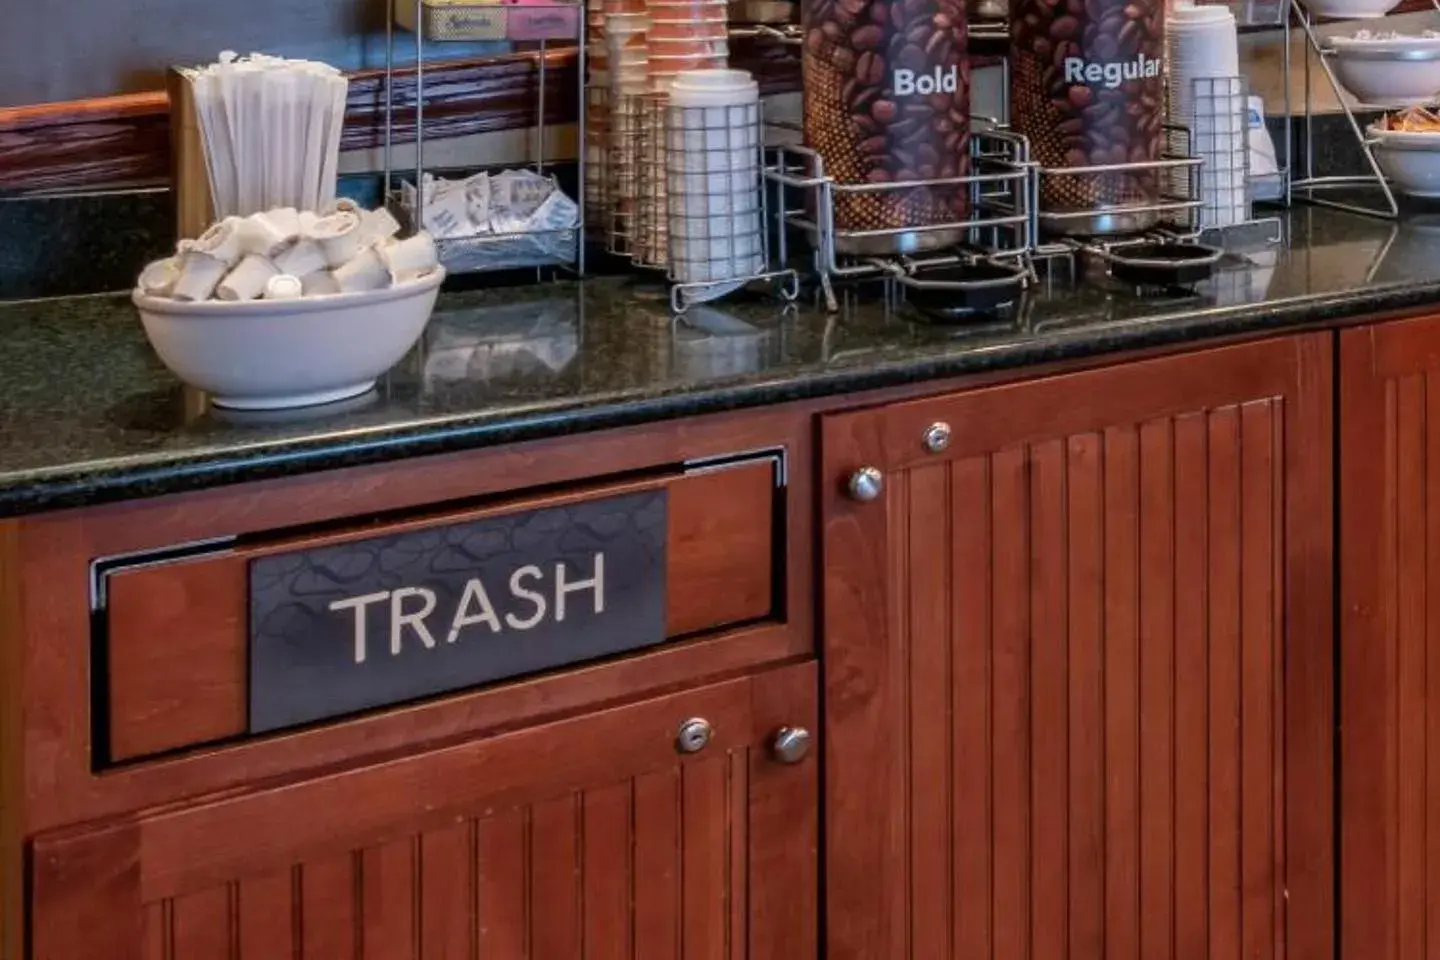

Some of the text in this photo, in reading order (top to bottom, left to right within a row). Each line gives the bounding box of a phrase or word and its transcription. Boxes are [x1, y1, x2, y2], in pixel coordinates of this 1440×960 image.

[893, 65, 958, 96] Bold
[1064, 53, 1161, 88] Regular
[330, 552, 605, 664] TRASH
